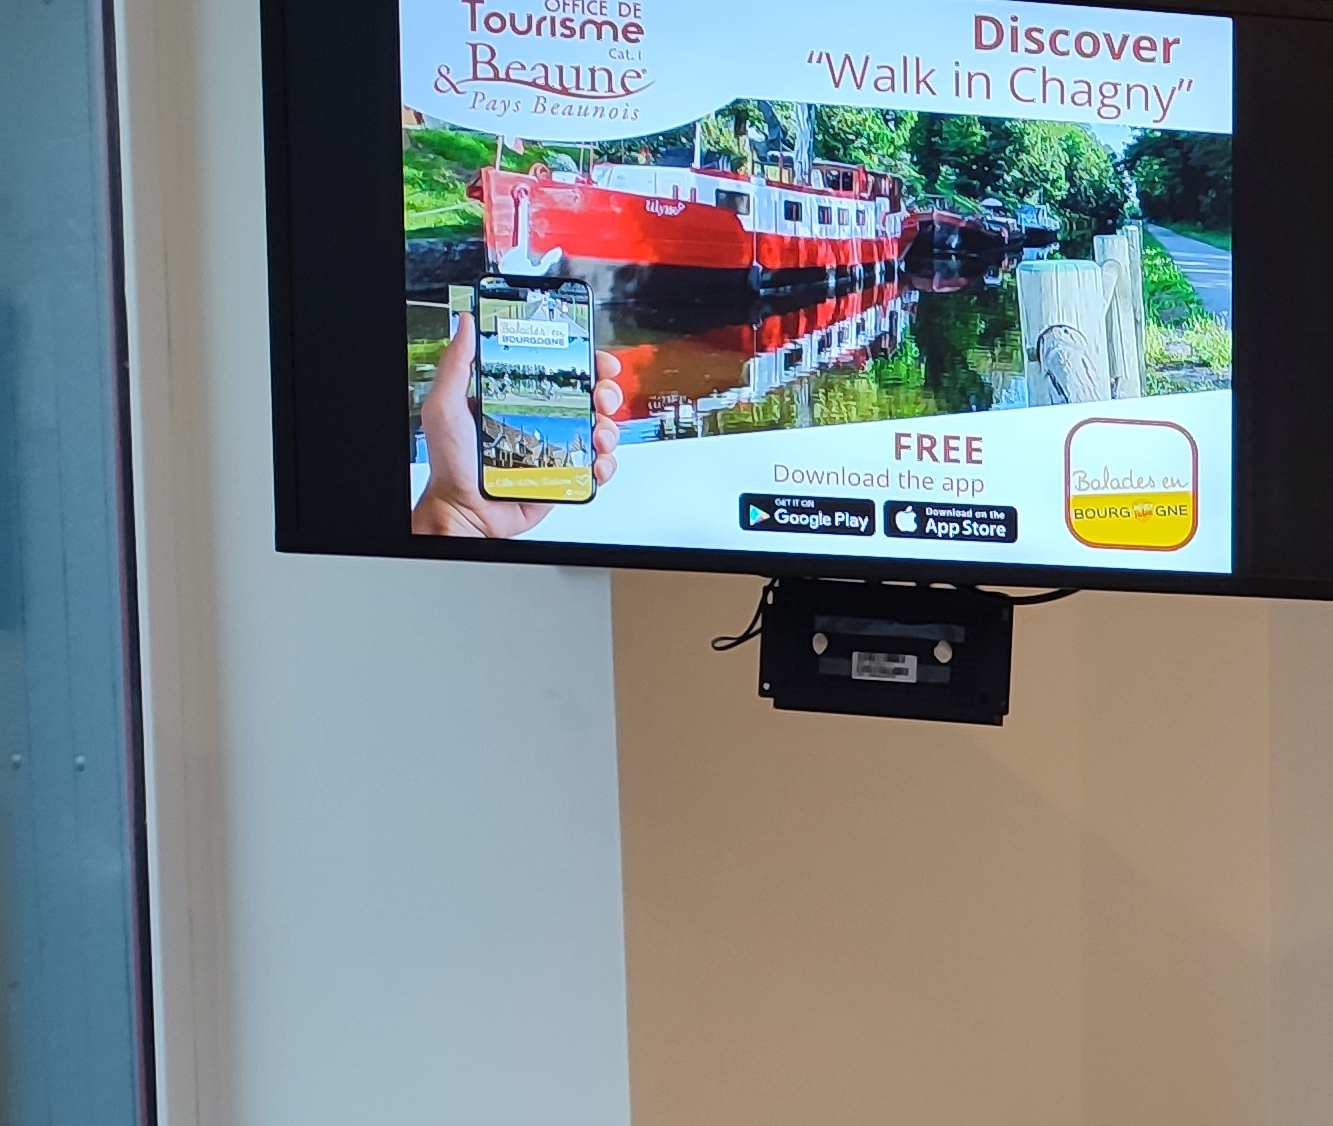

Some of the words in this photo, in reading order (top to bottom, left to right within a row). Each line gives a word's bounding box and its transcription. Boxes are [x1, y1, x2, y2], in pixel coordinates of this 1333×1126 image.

[461, 0, 645, 44] Tourisme
[544, 0, 608, 17] OFFICE
[618, 1, 642, 20] DE
[974, 13, 1181, 65] Discover
[608, 48, 635, 61] Cat.
[433, 64, 467, 95] &
[469, 90, 521, 117] Pays
[531, 94, 640, 121] Beaunois
[953, 61, 991, 101] in
[502, 335, 565, 346] BOURGOGNE
[894, 432, 984, 465] FREE
[774, 464, 894, 490] Download
[898, 468, 937, 491] the
[941, 474, 985, 498] app
[1073, 465, 1156, 492] Balades
[1162, 475, 1189, 490] en
[774, 498, 792, 507] GET
[800, 500, 815, 508] ON
[925, 507, 973, 518] Download
[975, 511, 987, 519] on
[989, 510, 1005, 520] the
[774, 508, 832, 529] Google
[834, 511, 869, 532] Play
[925, 518, 960, 538] App
[962, 520, 1007, 537] Store
